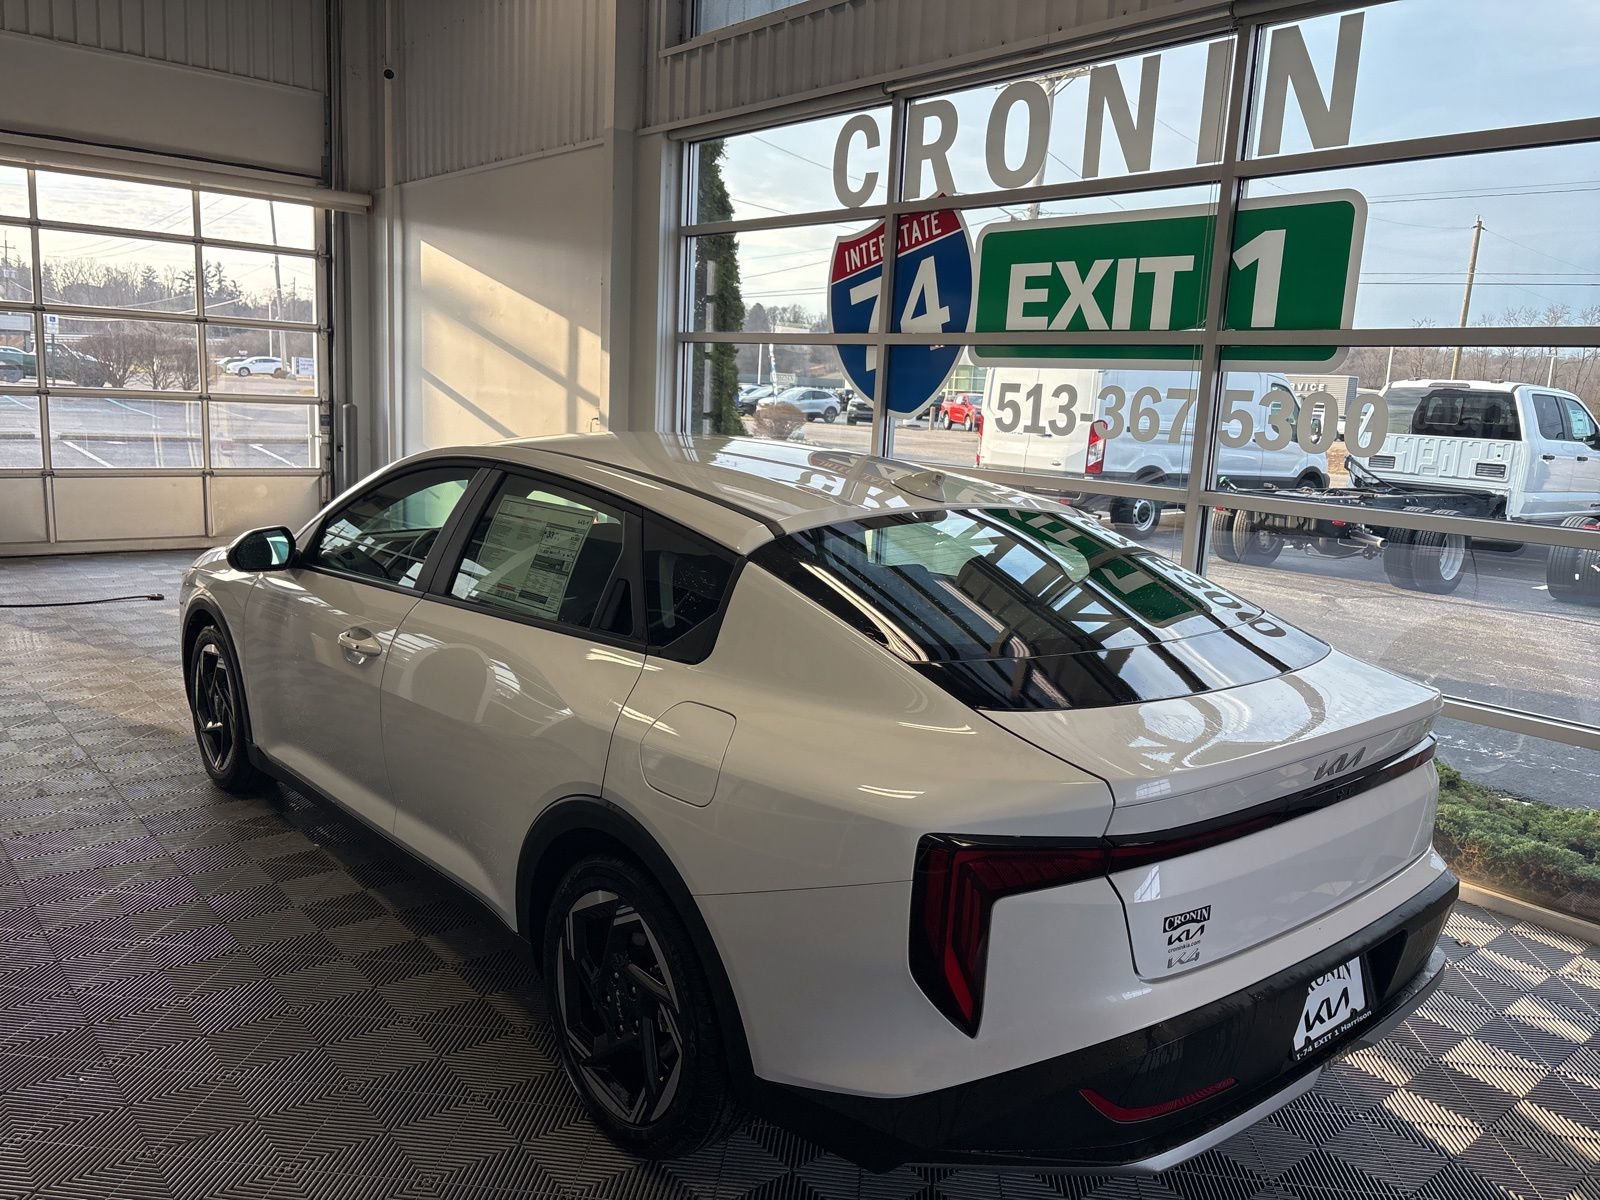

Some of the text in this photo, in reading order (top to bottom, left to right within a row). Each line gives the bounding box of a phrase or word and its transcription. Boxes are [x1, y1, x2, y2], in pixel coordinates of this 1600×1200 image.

[833, 12, 1366, 208] CRONIN
[845, 212, 942, 273] INTETATE
[1006, 229, 1287, 331] EXIT 1
[849, 255, 951, 372] 74
[1313, 746, 1367, 781] KIA
[1165, 907, 1210, 931] CRONIN
[1167, 924, 1205, 945] KIA
[1304, 986, 1350, 1033] KIA
[1314, 1033, 1333, 1048] EXIT
[1340, 1010, 1372, 1033] Harrison
